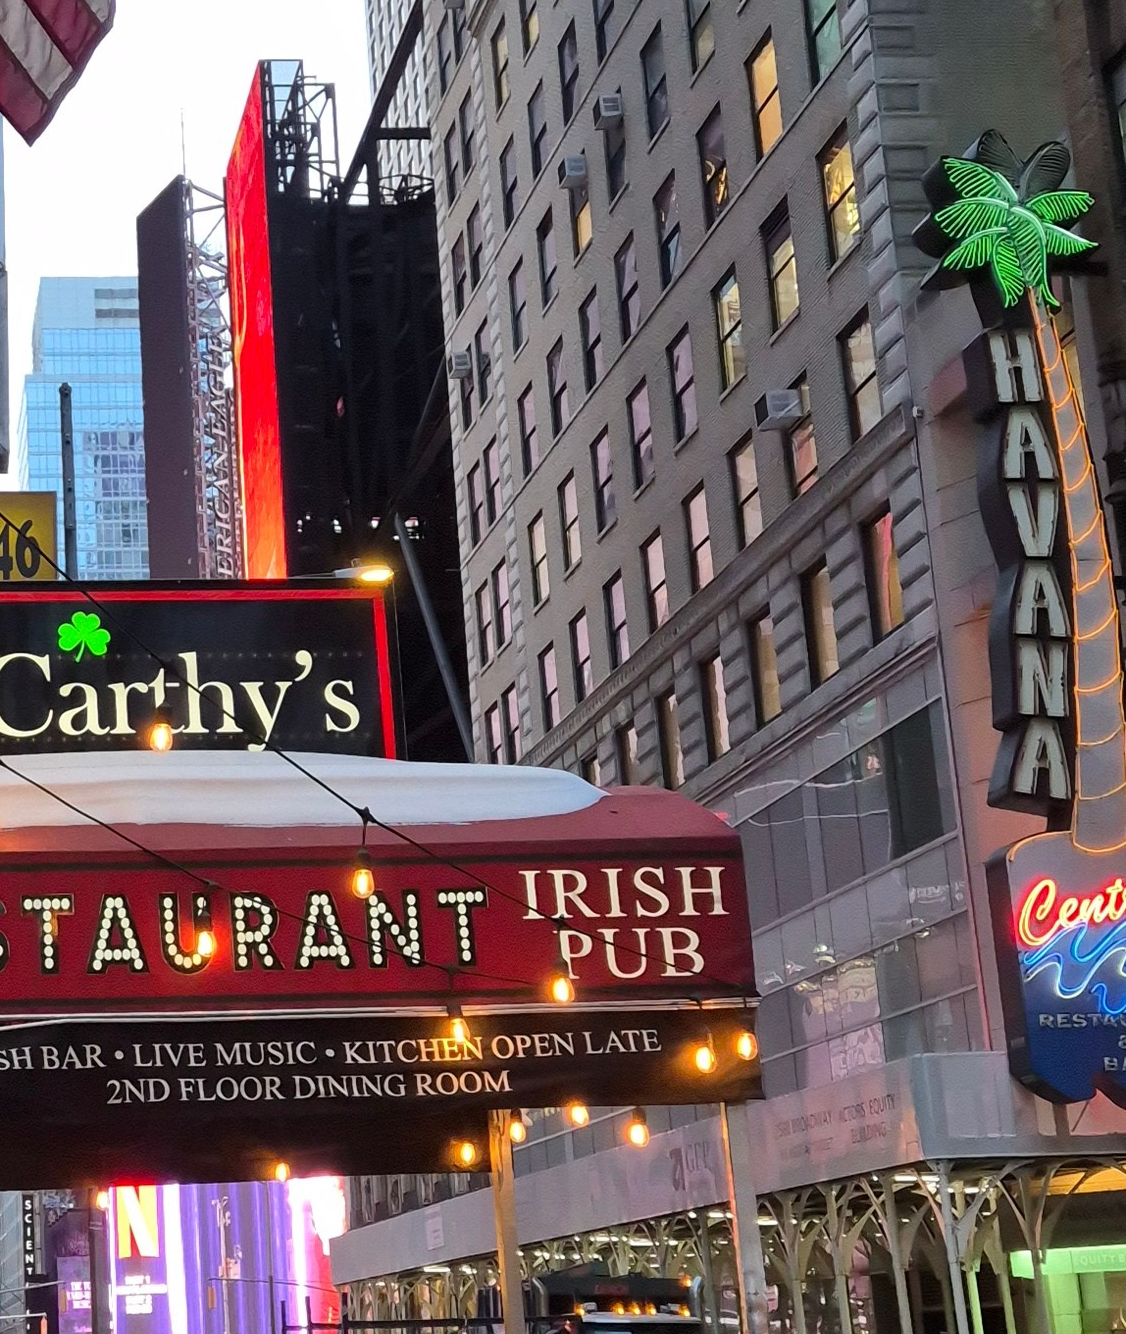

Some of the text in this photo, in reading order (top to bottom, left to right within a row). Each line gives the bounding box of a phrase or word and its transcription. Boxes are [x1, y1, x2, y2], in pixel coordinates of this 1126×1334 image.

[989, 332, 1073, 800] HAVANA
[518, 866, 730, 920] IRISH
[552, 927, 706, 980] PUB
[41, 1042, 106, 1070] BAR
[134, 1043, 204, 1069] LIVE
[214, 1040, 317, 1067] MUSIC
[344, 1036, 483, 1065] KITCHEN
[490, 1032, 575, 1060] OPEN
[585, 1029, 662, 1055] LATE
[106, 1069, 513, 1105] 2ND FLOOR DINING ROOM
